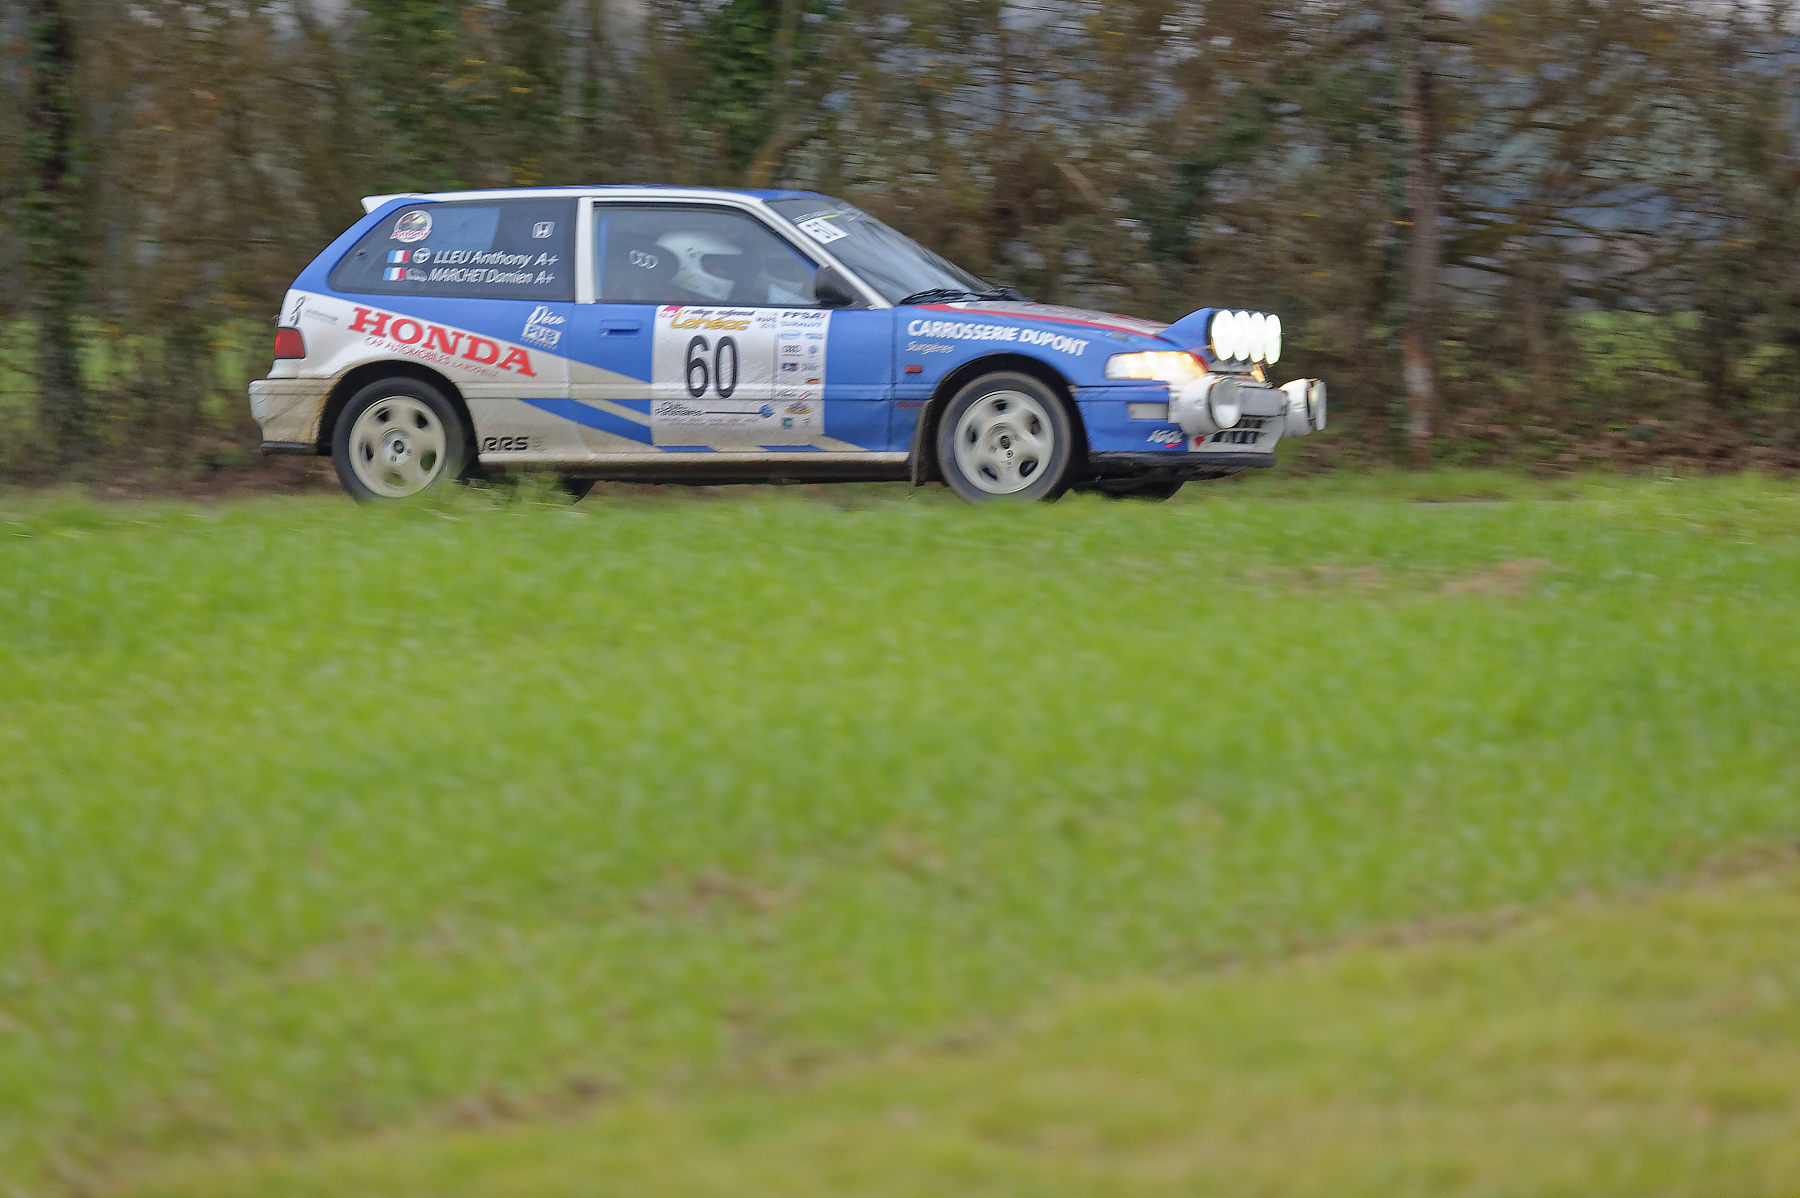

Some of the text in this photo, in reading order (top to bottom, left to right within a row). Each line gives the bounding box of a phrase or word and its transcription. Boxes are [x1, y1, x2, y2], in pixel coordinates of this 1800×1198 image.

[433, 250, 559, 267] LLEU Anthony A+
[427, 268, 487, 283] MARCHET
[486, 269, 533, 284] Damien
[533, 271, 556, 284] A+
[671, 310, 750, 331] Lohéac
[348, 306, 538, 378] HONDA
[907, 319, 1090, 357] CARROSSERIE DUPONT
[686, 334, 738, 399] 60
[481, 436, 529, 451] RRS
